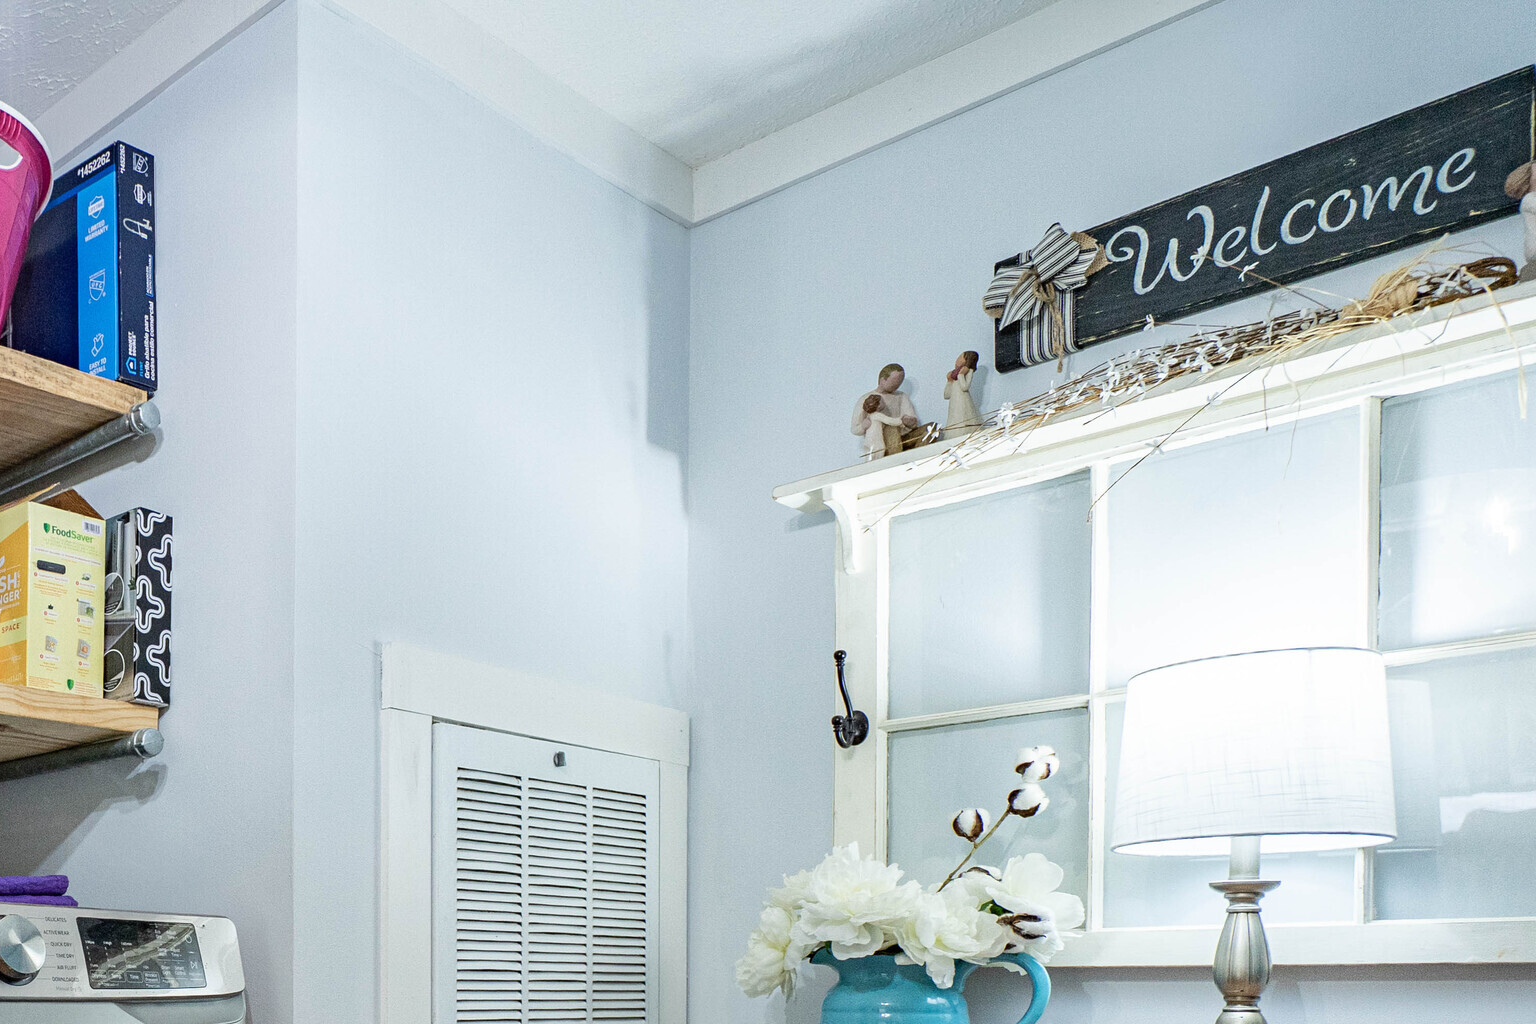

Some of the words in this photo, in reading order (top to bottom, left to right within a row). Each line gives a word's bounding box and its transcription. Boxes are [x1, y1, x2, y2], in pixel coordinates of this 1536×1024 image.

[1103, 146, 1477, 295] Welcome
[89, 359, 100, 371] EASY
[52, 525, 93, 543] FoodSaver
[2, 622, 21, 634] SPACE
